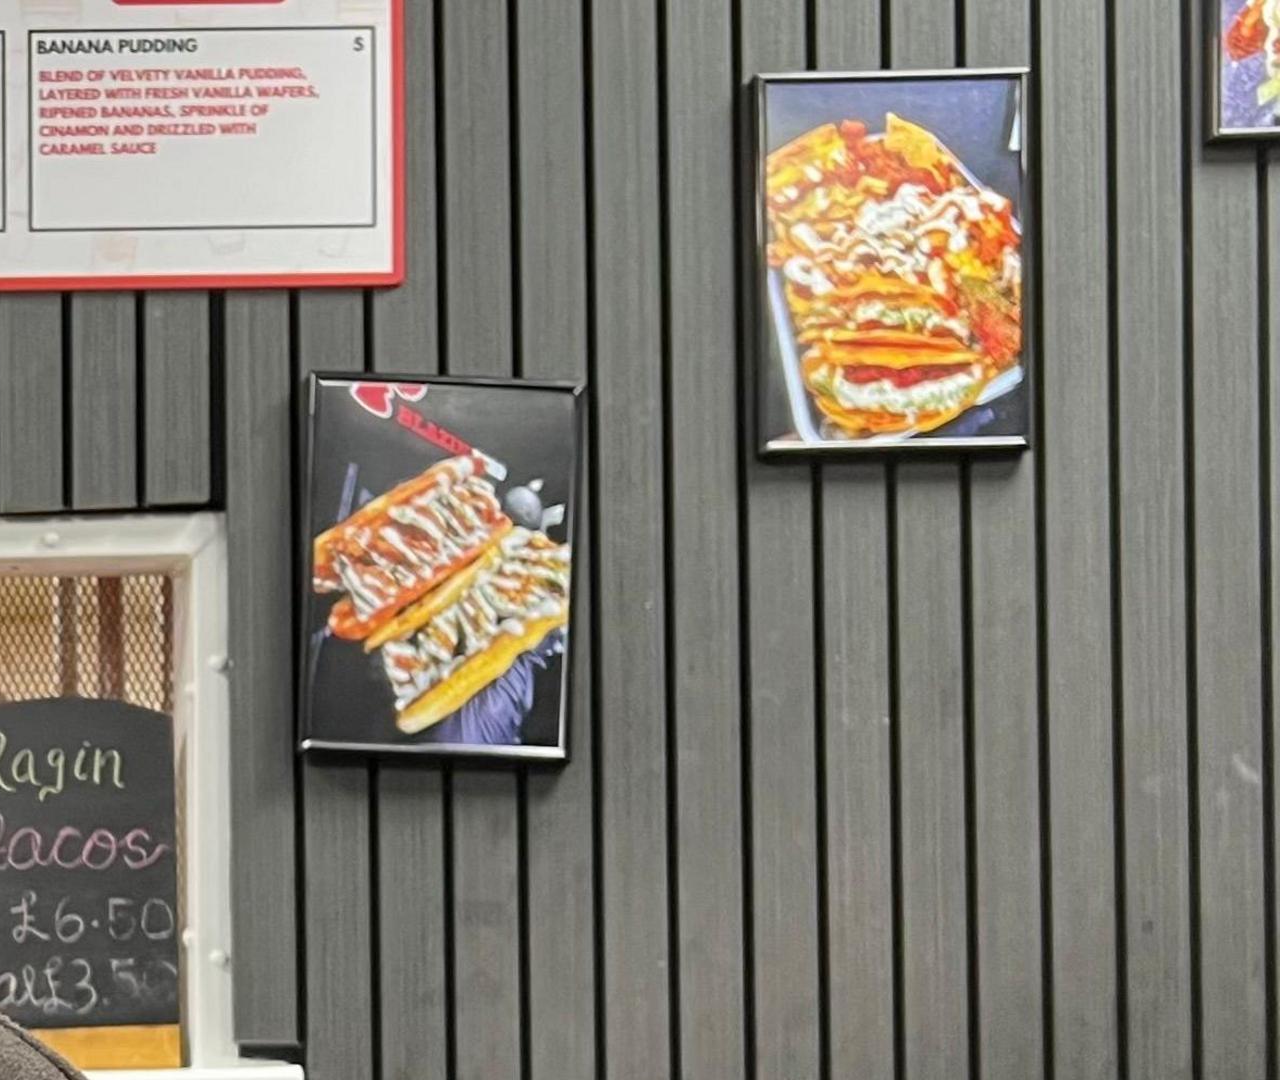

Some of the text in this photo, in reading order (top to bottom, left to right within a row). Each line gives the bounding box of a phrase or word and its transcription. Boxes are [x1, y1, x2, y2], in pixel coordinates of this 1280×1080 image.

[37, 38, 198, 54] BANANA PUDDING
[353, 37, 365, 52] 5
[39, 70, 83, 82] BLEND
[87, 70, 105, 81] OF
[110, 69, 171, 82] VELVETY
[174, 69, 236, 81] VANILLA
[39, 89, 101, 101] LAYERED
[105, 88, 142, 100] WITH
[145, 88, 189, 100] FRESH
[192, 87, 253, 99] VANILLA
[39, 106, 98, 119] RIPENED
[179, 105, 247, 117] SPRINKLE
[251, 104, 270, 117] OF
[39, 123, 257, 137] CINAMON AND DRIZZLED WITH
[39, 142, 157, 156] CARAMEL SAUCE
[9, 890, 175, 945] £6.50
